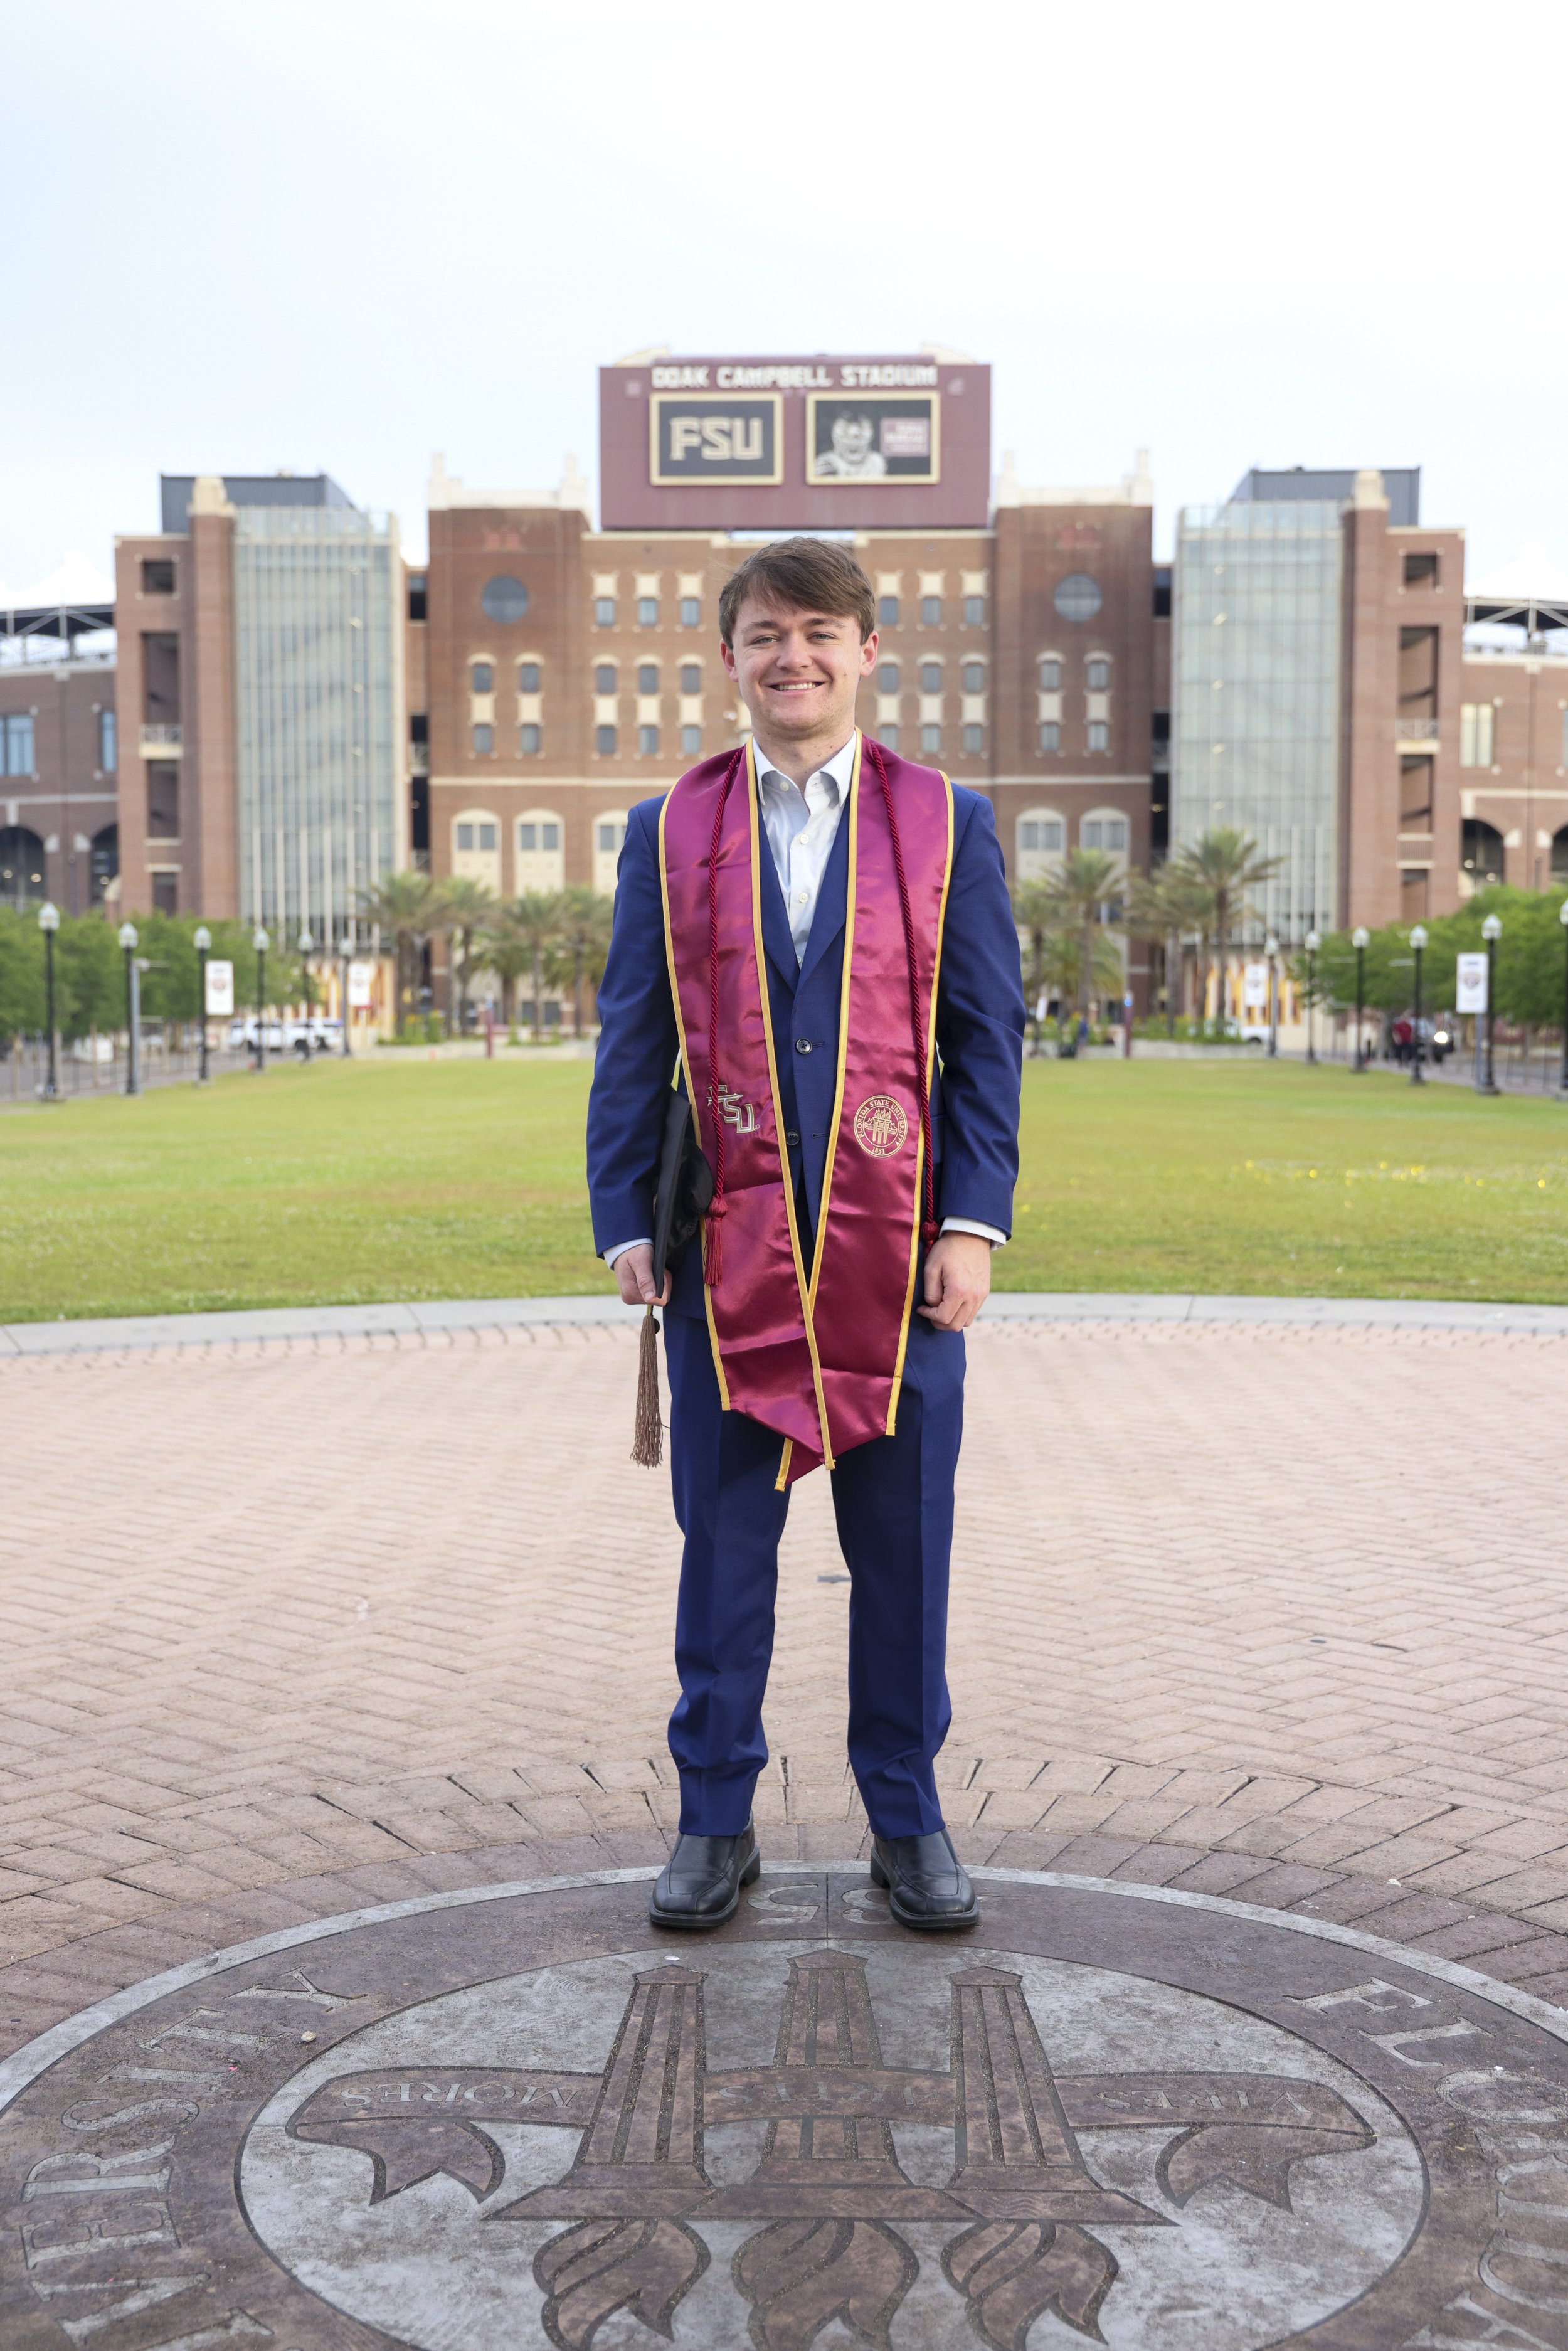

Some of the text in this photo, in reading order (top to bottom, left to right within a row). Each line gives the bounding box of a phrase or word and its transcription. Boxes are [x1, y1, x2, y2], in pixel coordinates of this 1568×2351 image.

[652, 365, 938, 388] DOAK CAMPBELL STADIUM
[670, 416, 763, 461] FSU
[857, 1099, 904, 1147] FLORIDA STATE UNIVERSITY
[871, 1146, 885, 1154] 1851
[340, 2081, 584, 2108] MORES
[1095, 2088, 1312, 2114] VIRES
